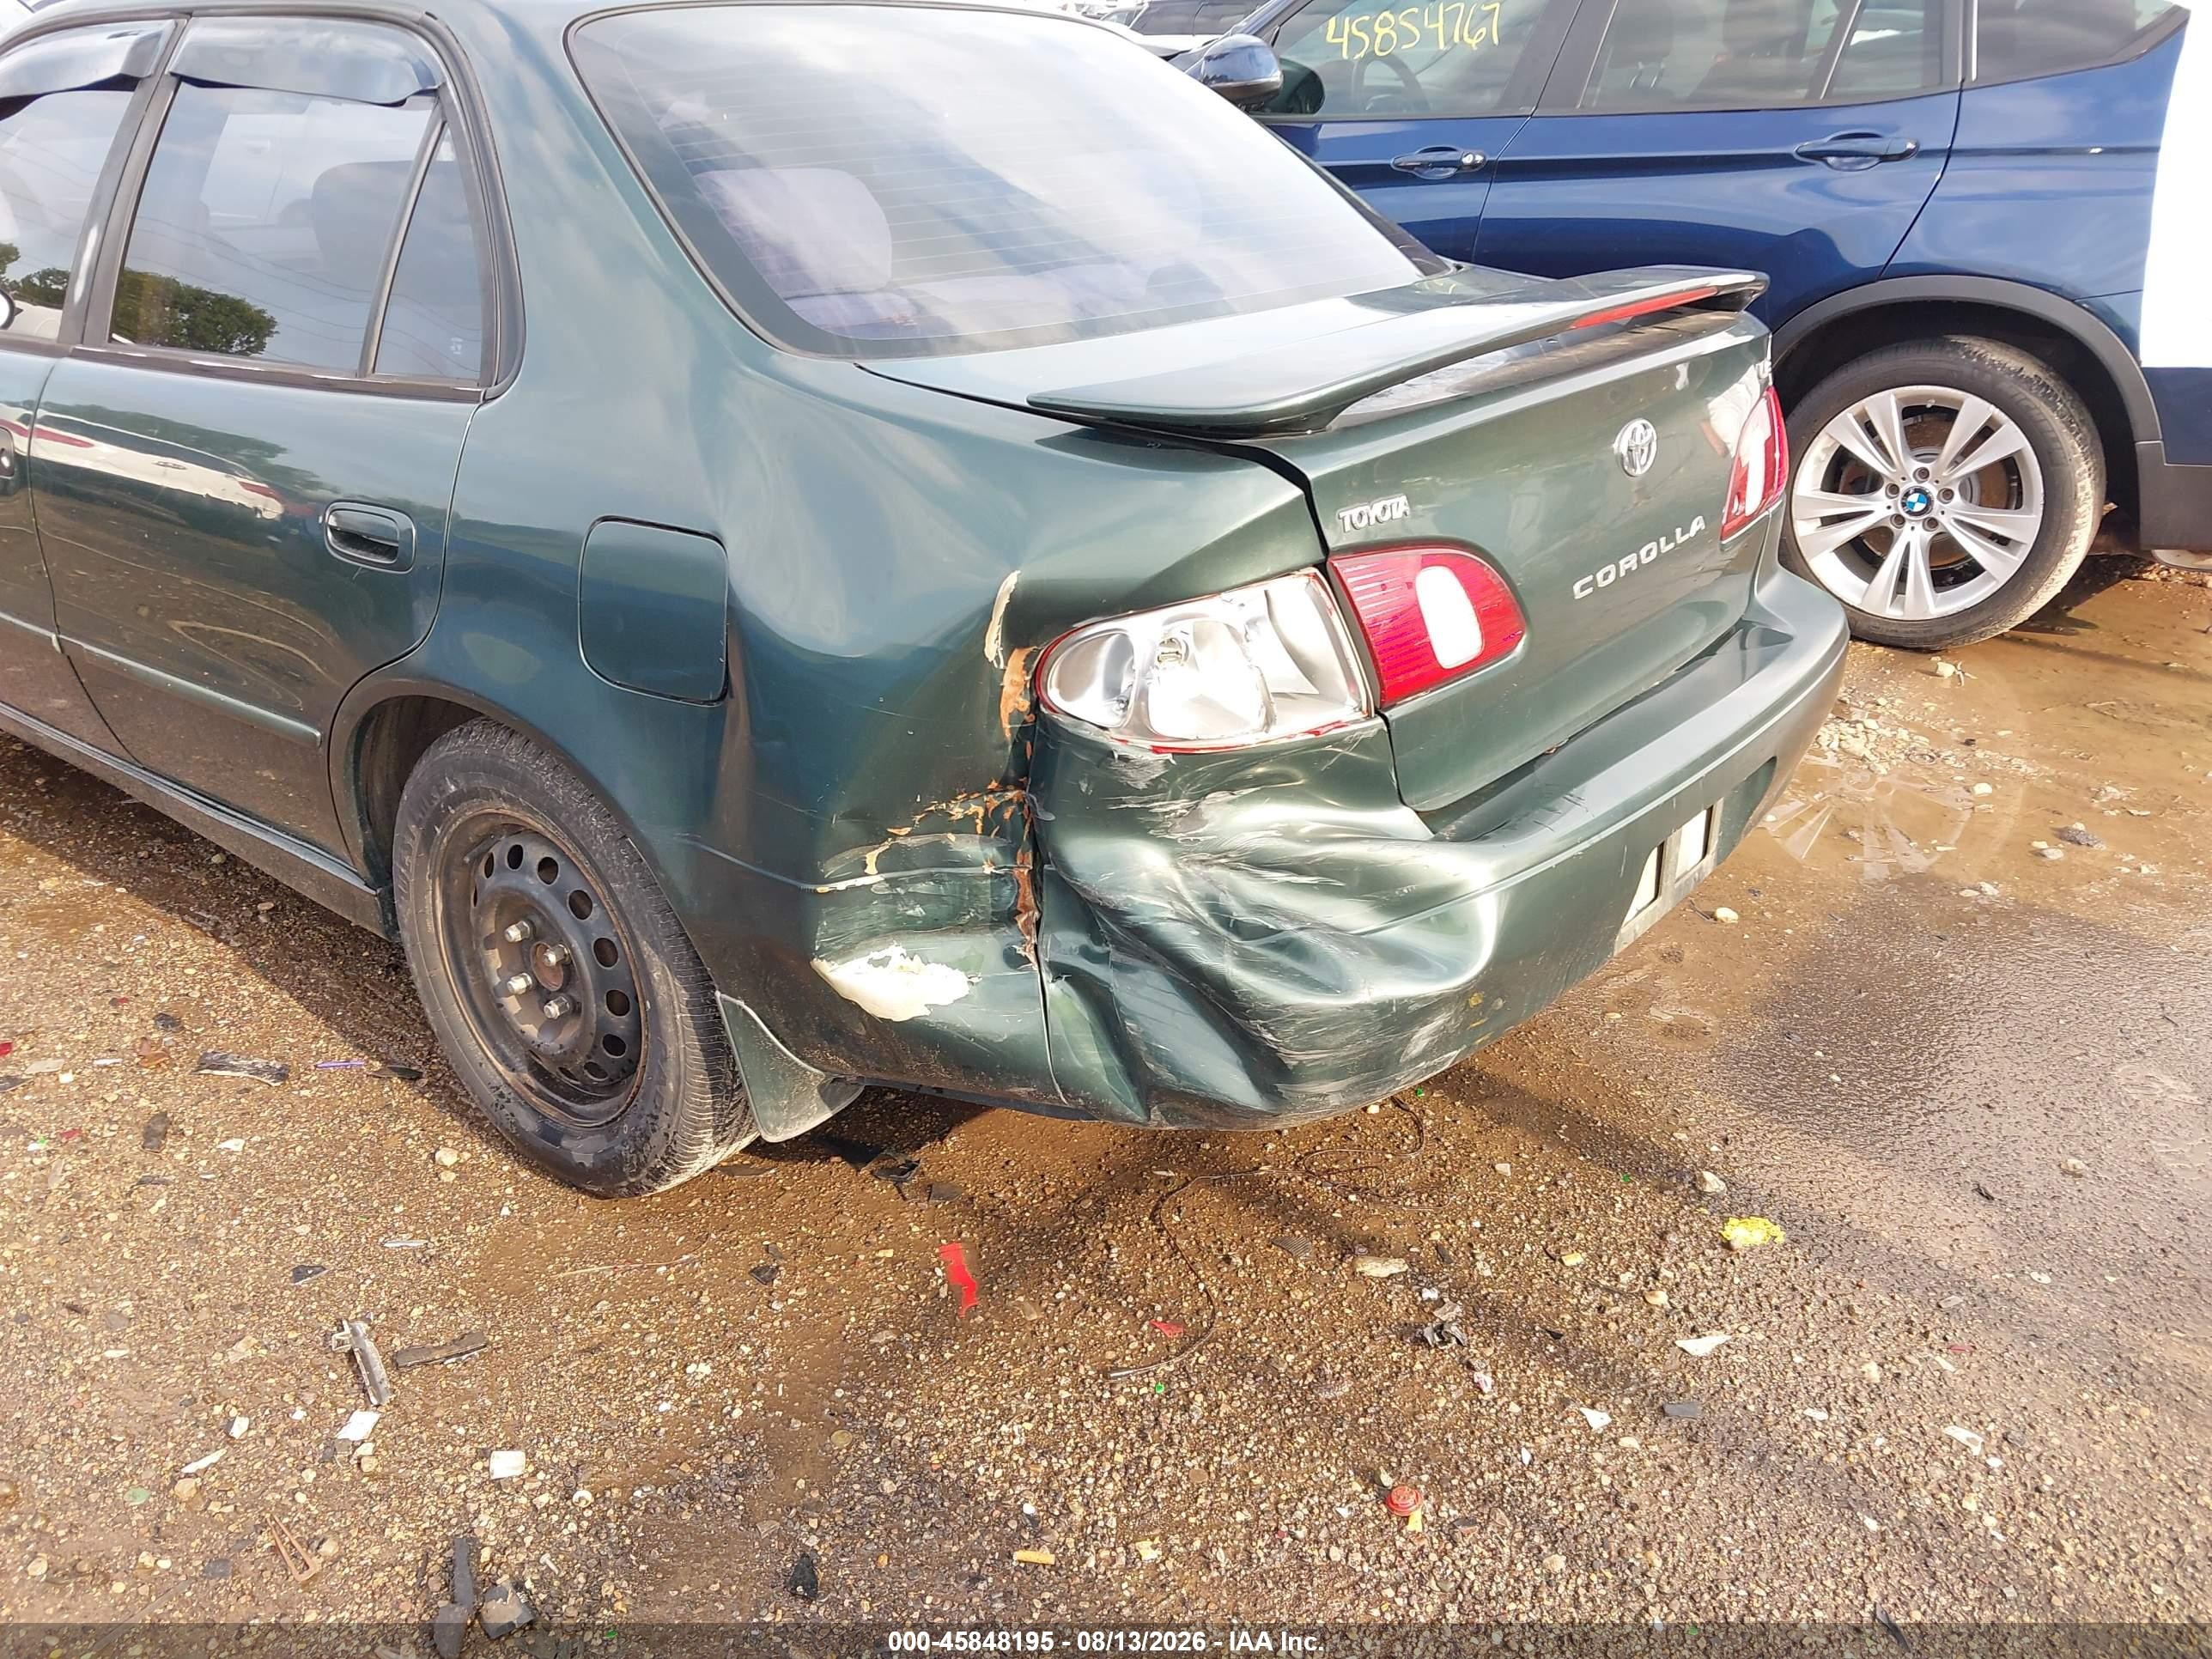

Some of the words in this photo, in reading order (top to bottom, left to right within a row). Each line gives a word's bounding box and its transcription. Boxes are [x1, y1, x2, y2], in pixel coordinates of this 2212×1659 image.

[1326, 3, 1500, 60] 45854767
[1337, 494, 1410, 532] TOYOTA
[1573, 515, 1706, 599] COROLLA
